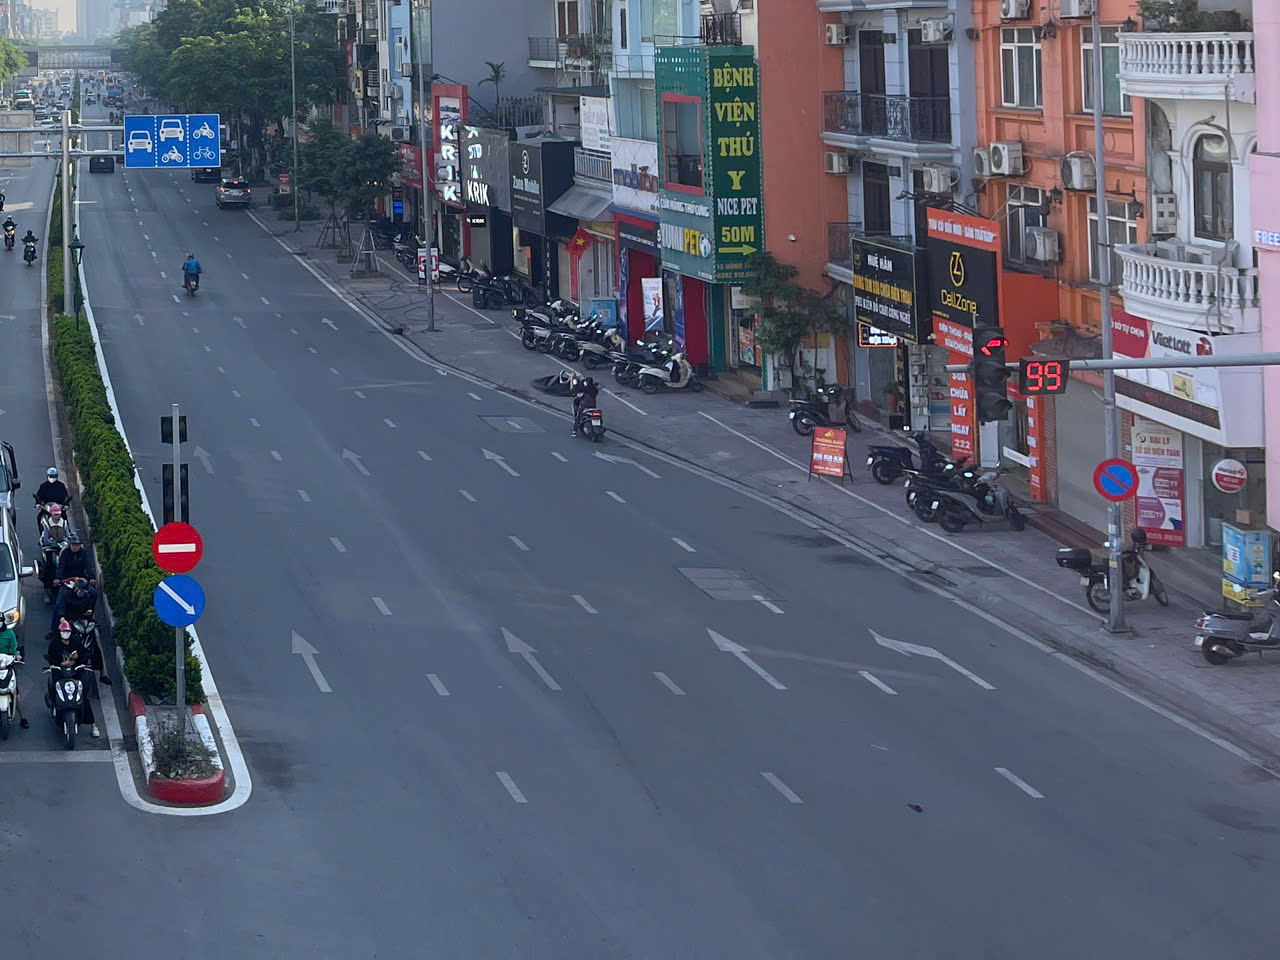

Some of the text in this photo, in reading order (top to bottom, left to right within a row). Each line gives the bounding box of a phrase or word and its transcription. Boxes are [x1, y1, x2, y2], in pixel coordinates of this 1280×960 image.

[713, 62, 754, 93] BỆNH
[714, 96, 755, 127] VIỆN
[717, 131, 754, 156] THÚ
[727, 170, 746, 190] Y
[467, 180, 490, 206] KRIK
[717, 197, 758, 216] NICE PET
[721, 225, 755, 243] 50M
[941, 289, 977, 313] CellZone
[1152, 330, 1192, 354] Vietlott
[1026, 362, 1062, 391] 99
[951, 423, 969, 435] NGAY
[954, 439, 971, 449] 222
